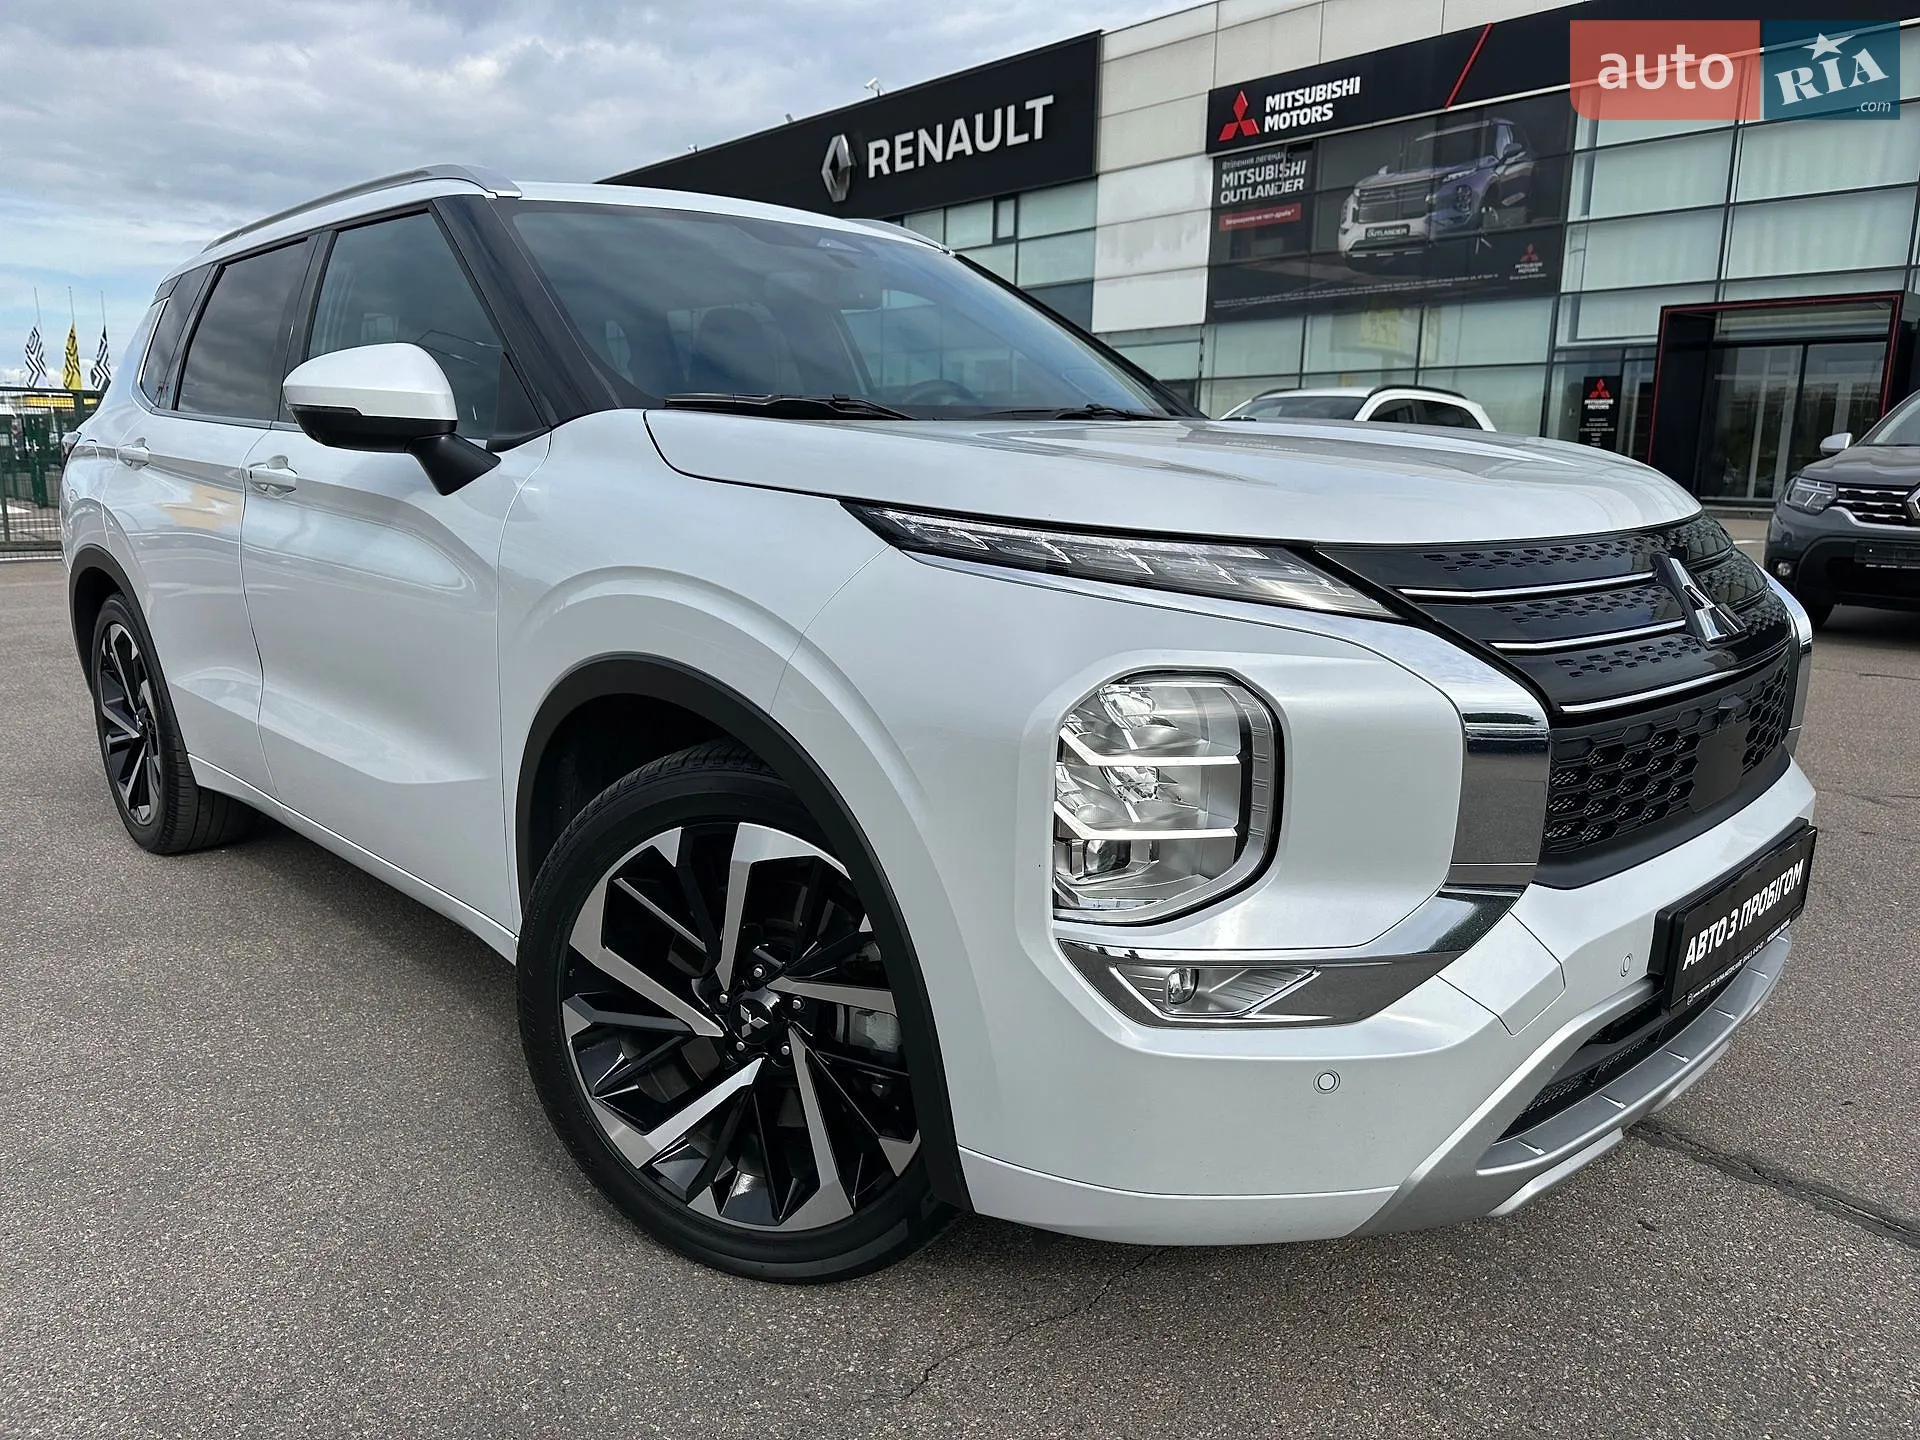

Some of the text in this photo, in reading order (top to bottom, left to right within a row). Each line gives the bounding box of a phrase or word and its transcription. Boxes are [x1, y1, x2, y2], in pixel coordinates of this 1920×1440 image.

[1265, 76, 1361, 113] MITSUBISHI
[1264, 103, 1334, 132] MOTORS
[867, 94, 1054, 179] RENAULT
[1221, 160, 1306, 188] MITSUBISHI
[1220, 178, 1304, 204] OUTLANDER
[1682, 916, 1727, 971] АВТО
[1738, 859, 1805, 931] ПРОБІГОМ
